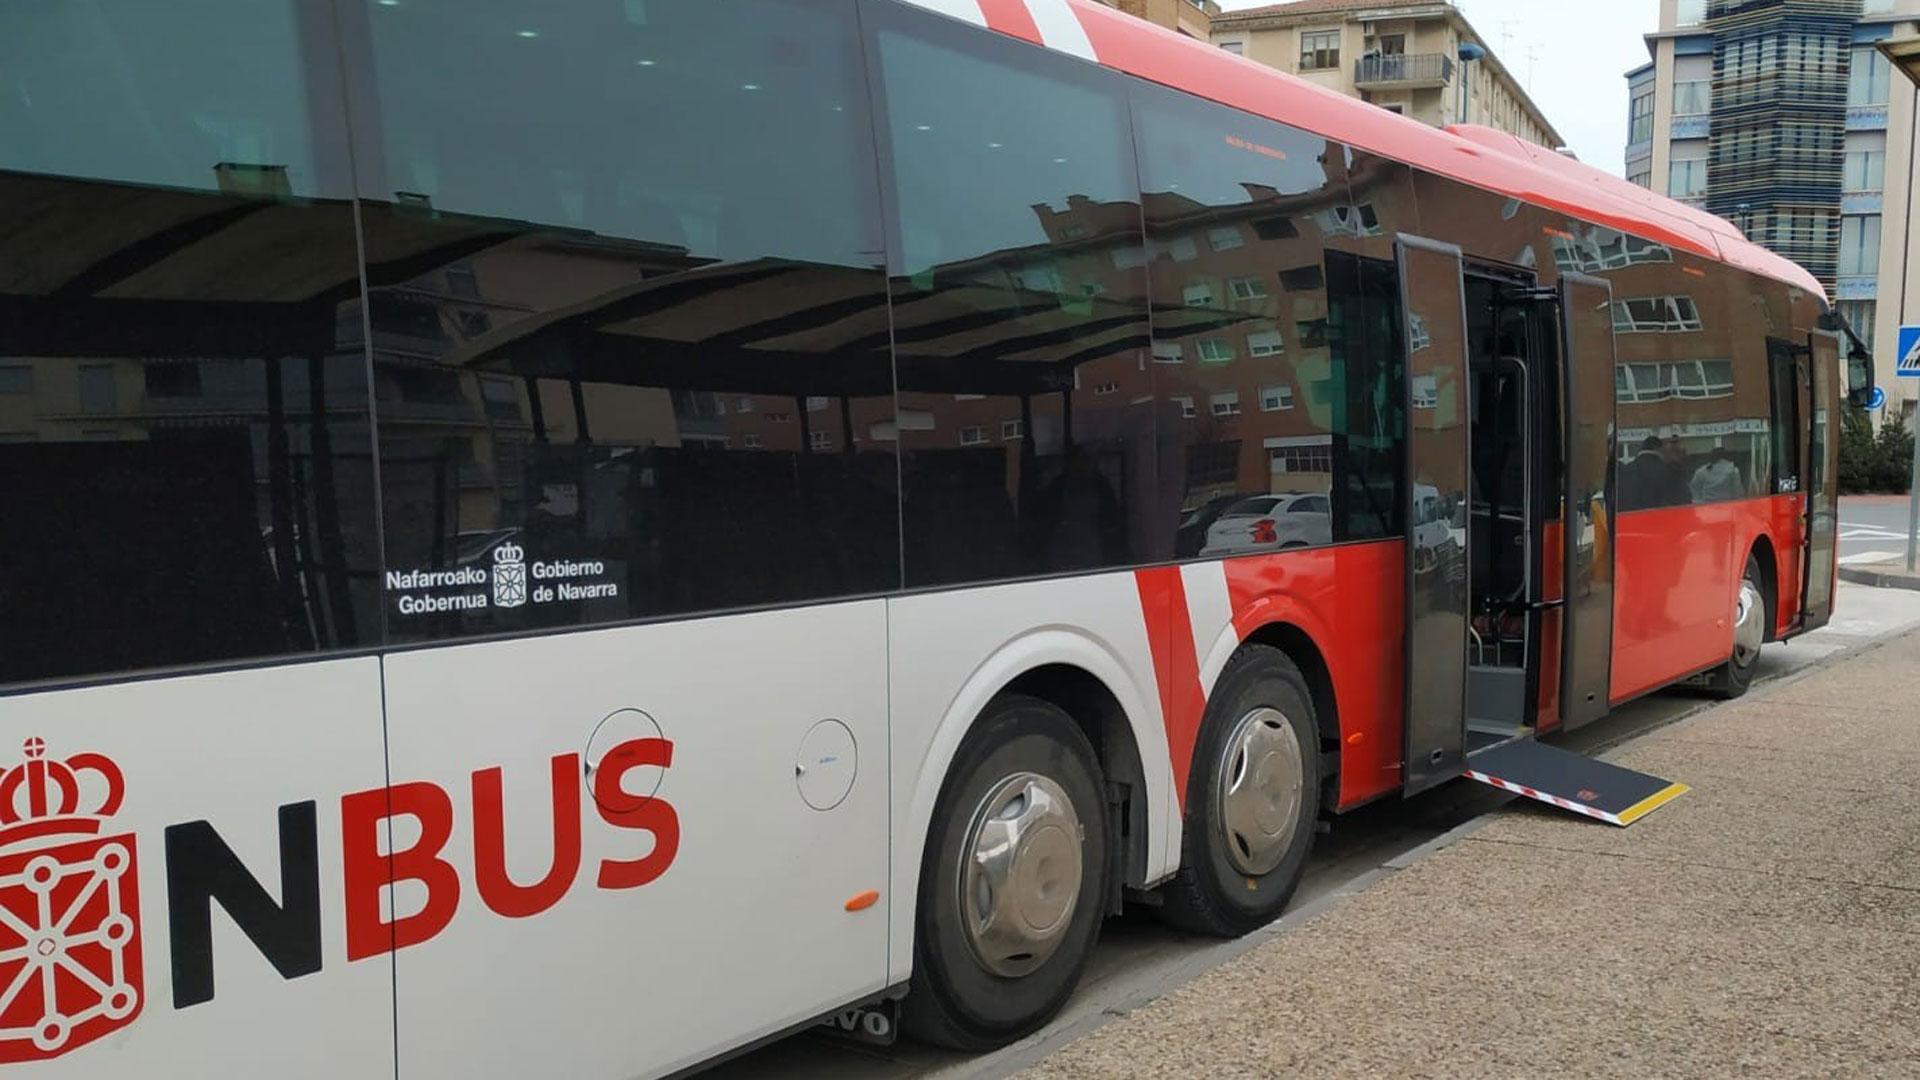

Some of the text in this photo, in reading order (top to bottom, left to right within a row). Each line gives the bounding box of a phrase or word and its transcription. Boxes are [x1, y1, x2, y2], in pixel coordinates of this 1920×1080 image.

[387, 567, 486, 589] Nafarroako
[533, 560, 603, 578] Gobierno
[533, 583, 617, 602] de Navarra
[399, 594, 487, 614] Gobernua
